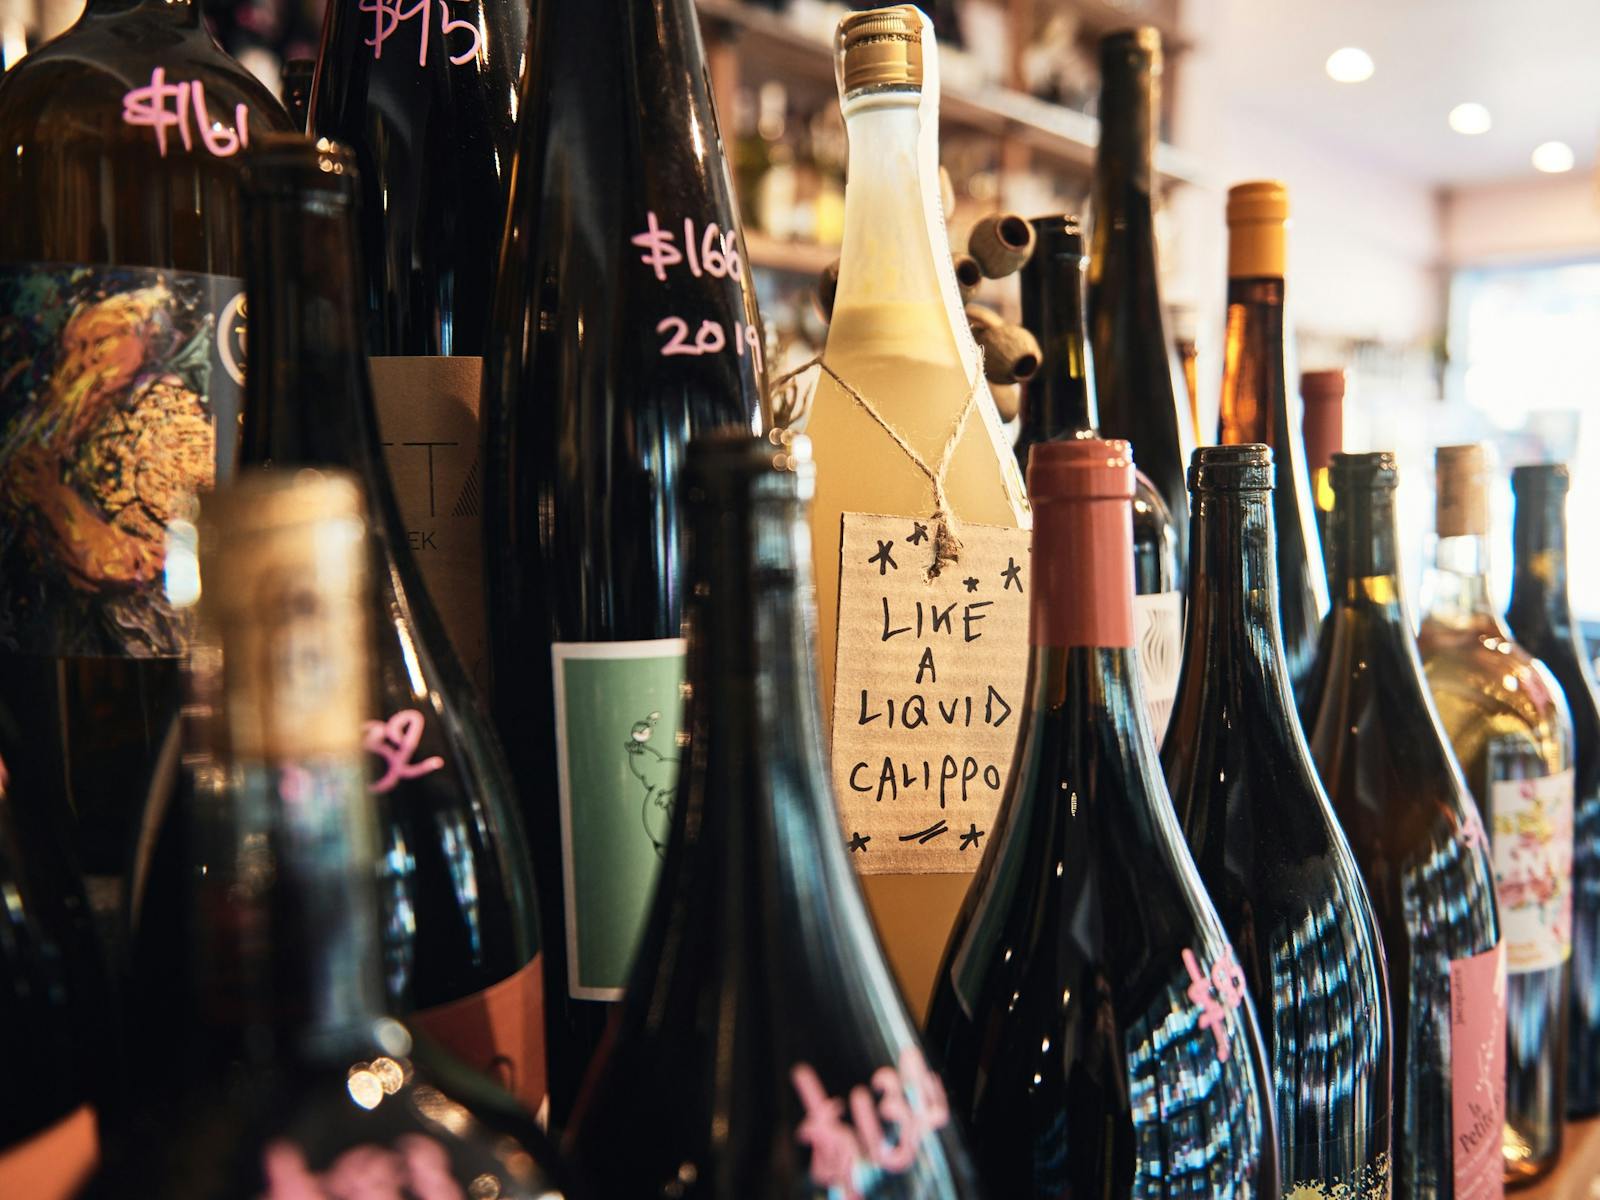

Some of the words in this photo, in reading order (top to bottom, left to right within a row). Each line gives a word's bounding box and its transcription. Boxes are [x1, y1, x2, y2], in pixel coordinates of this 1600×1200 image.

[122, 67, 249, 157] $161
[630, 211, 742, 282] $166
[655, 316, 763, 373] 2019
[882, 597, 994, 642] LIKE
[915, 646, 936, 684] A
[850, 754, 1001, 809] CALIPPO
